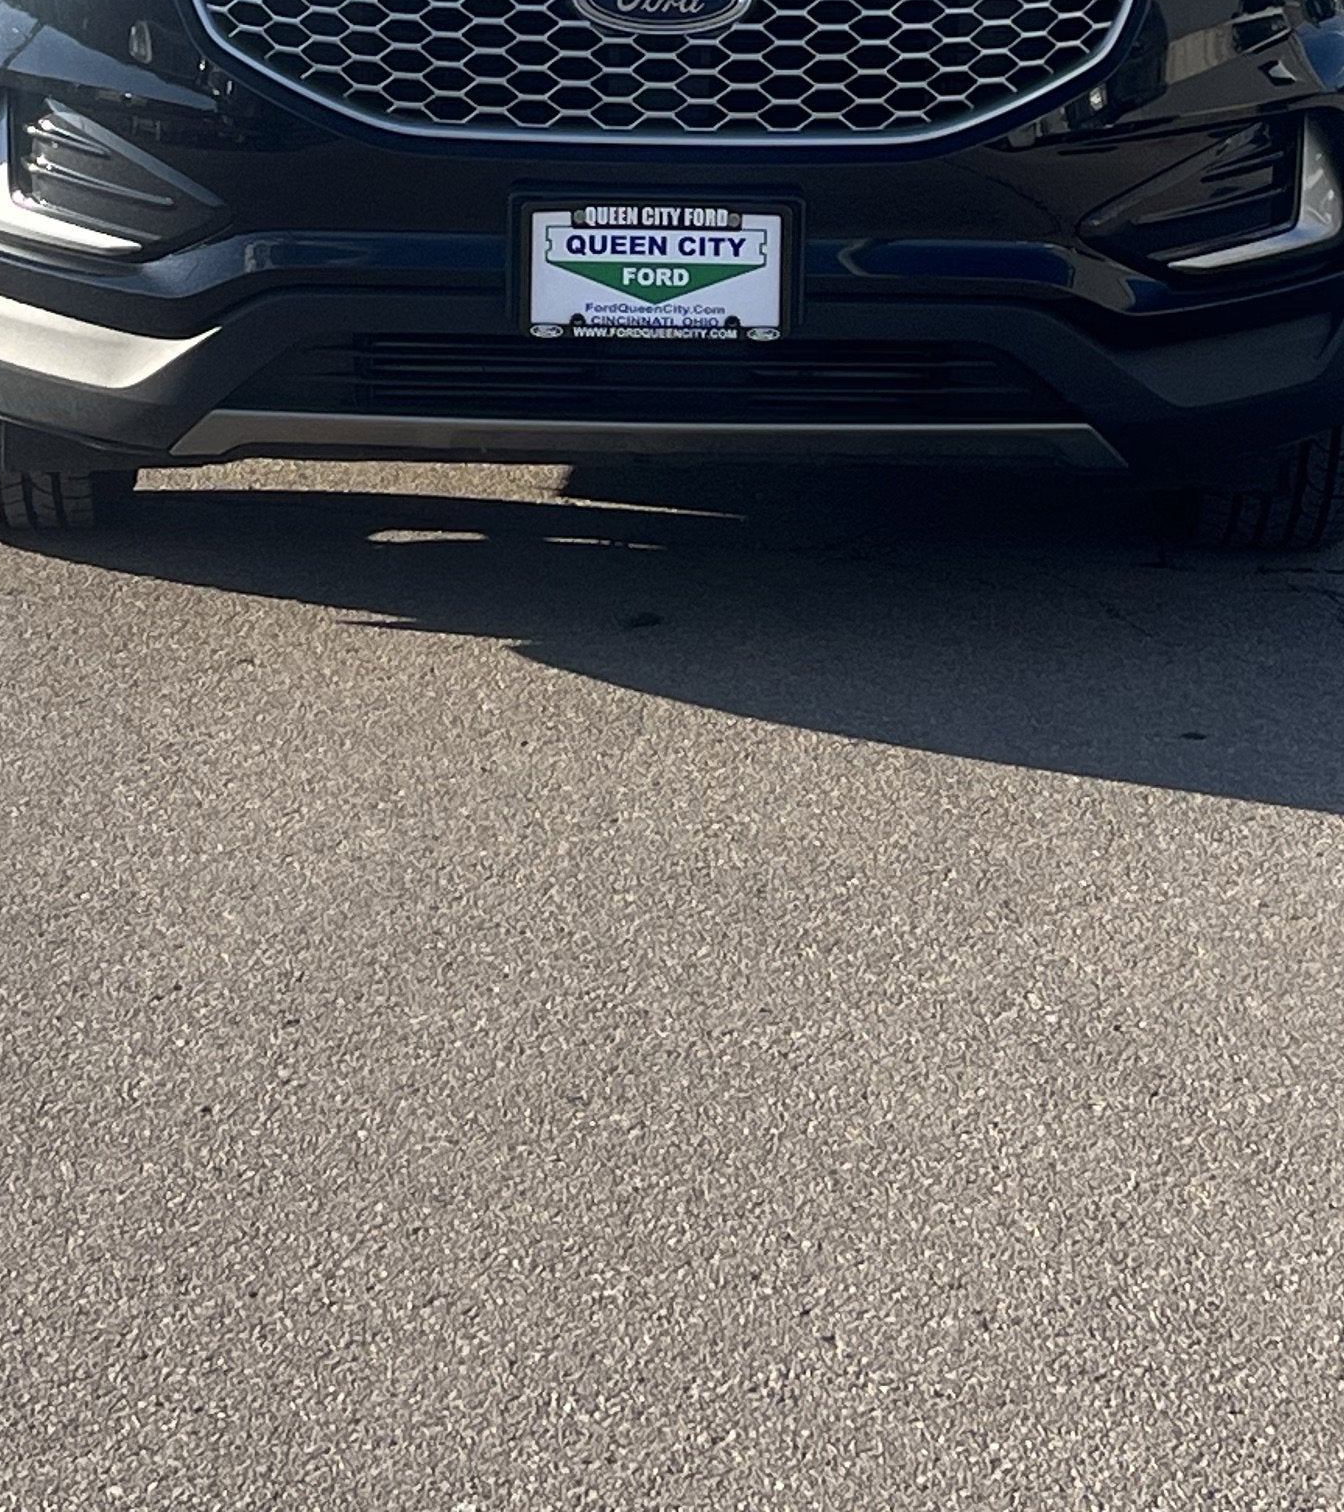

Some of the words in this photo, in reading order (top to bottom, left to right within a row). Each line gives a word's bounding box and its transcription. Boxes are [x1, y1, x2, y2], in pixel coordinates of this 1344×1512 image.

[585, 206, 639, 227] QUEEN
[641, 207, 682, 226] CITY
[684, 208, 729, 227] FORD
[565, 234, 667, 257] QUEEN
[678, 236, 747, 257] CITY
[622, 267, 690, 286] FORD
[585, 302, 726, 316] FordQueenCity.Com
[573, 327, 738, 339] WWW.FORDQUEENCITY.COM
